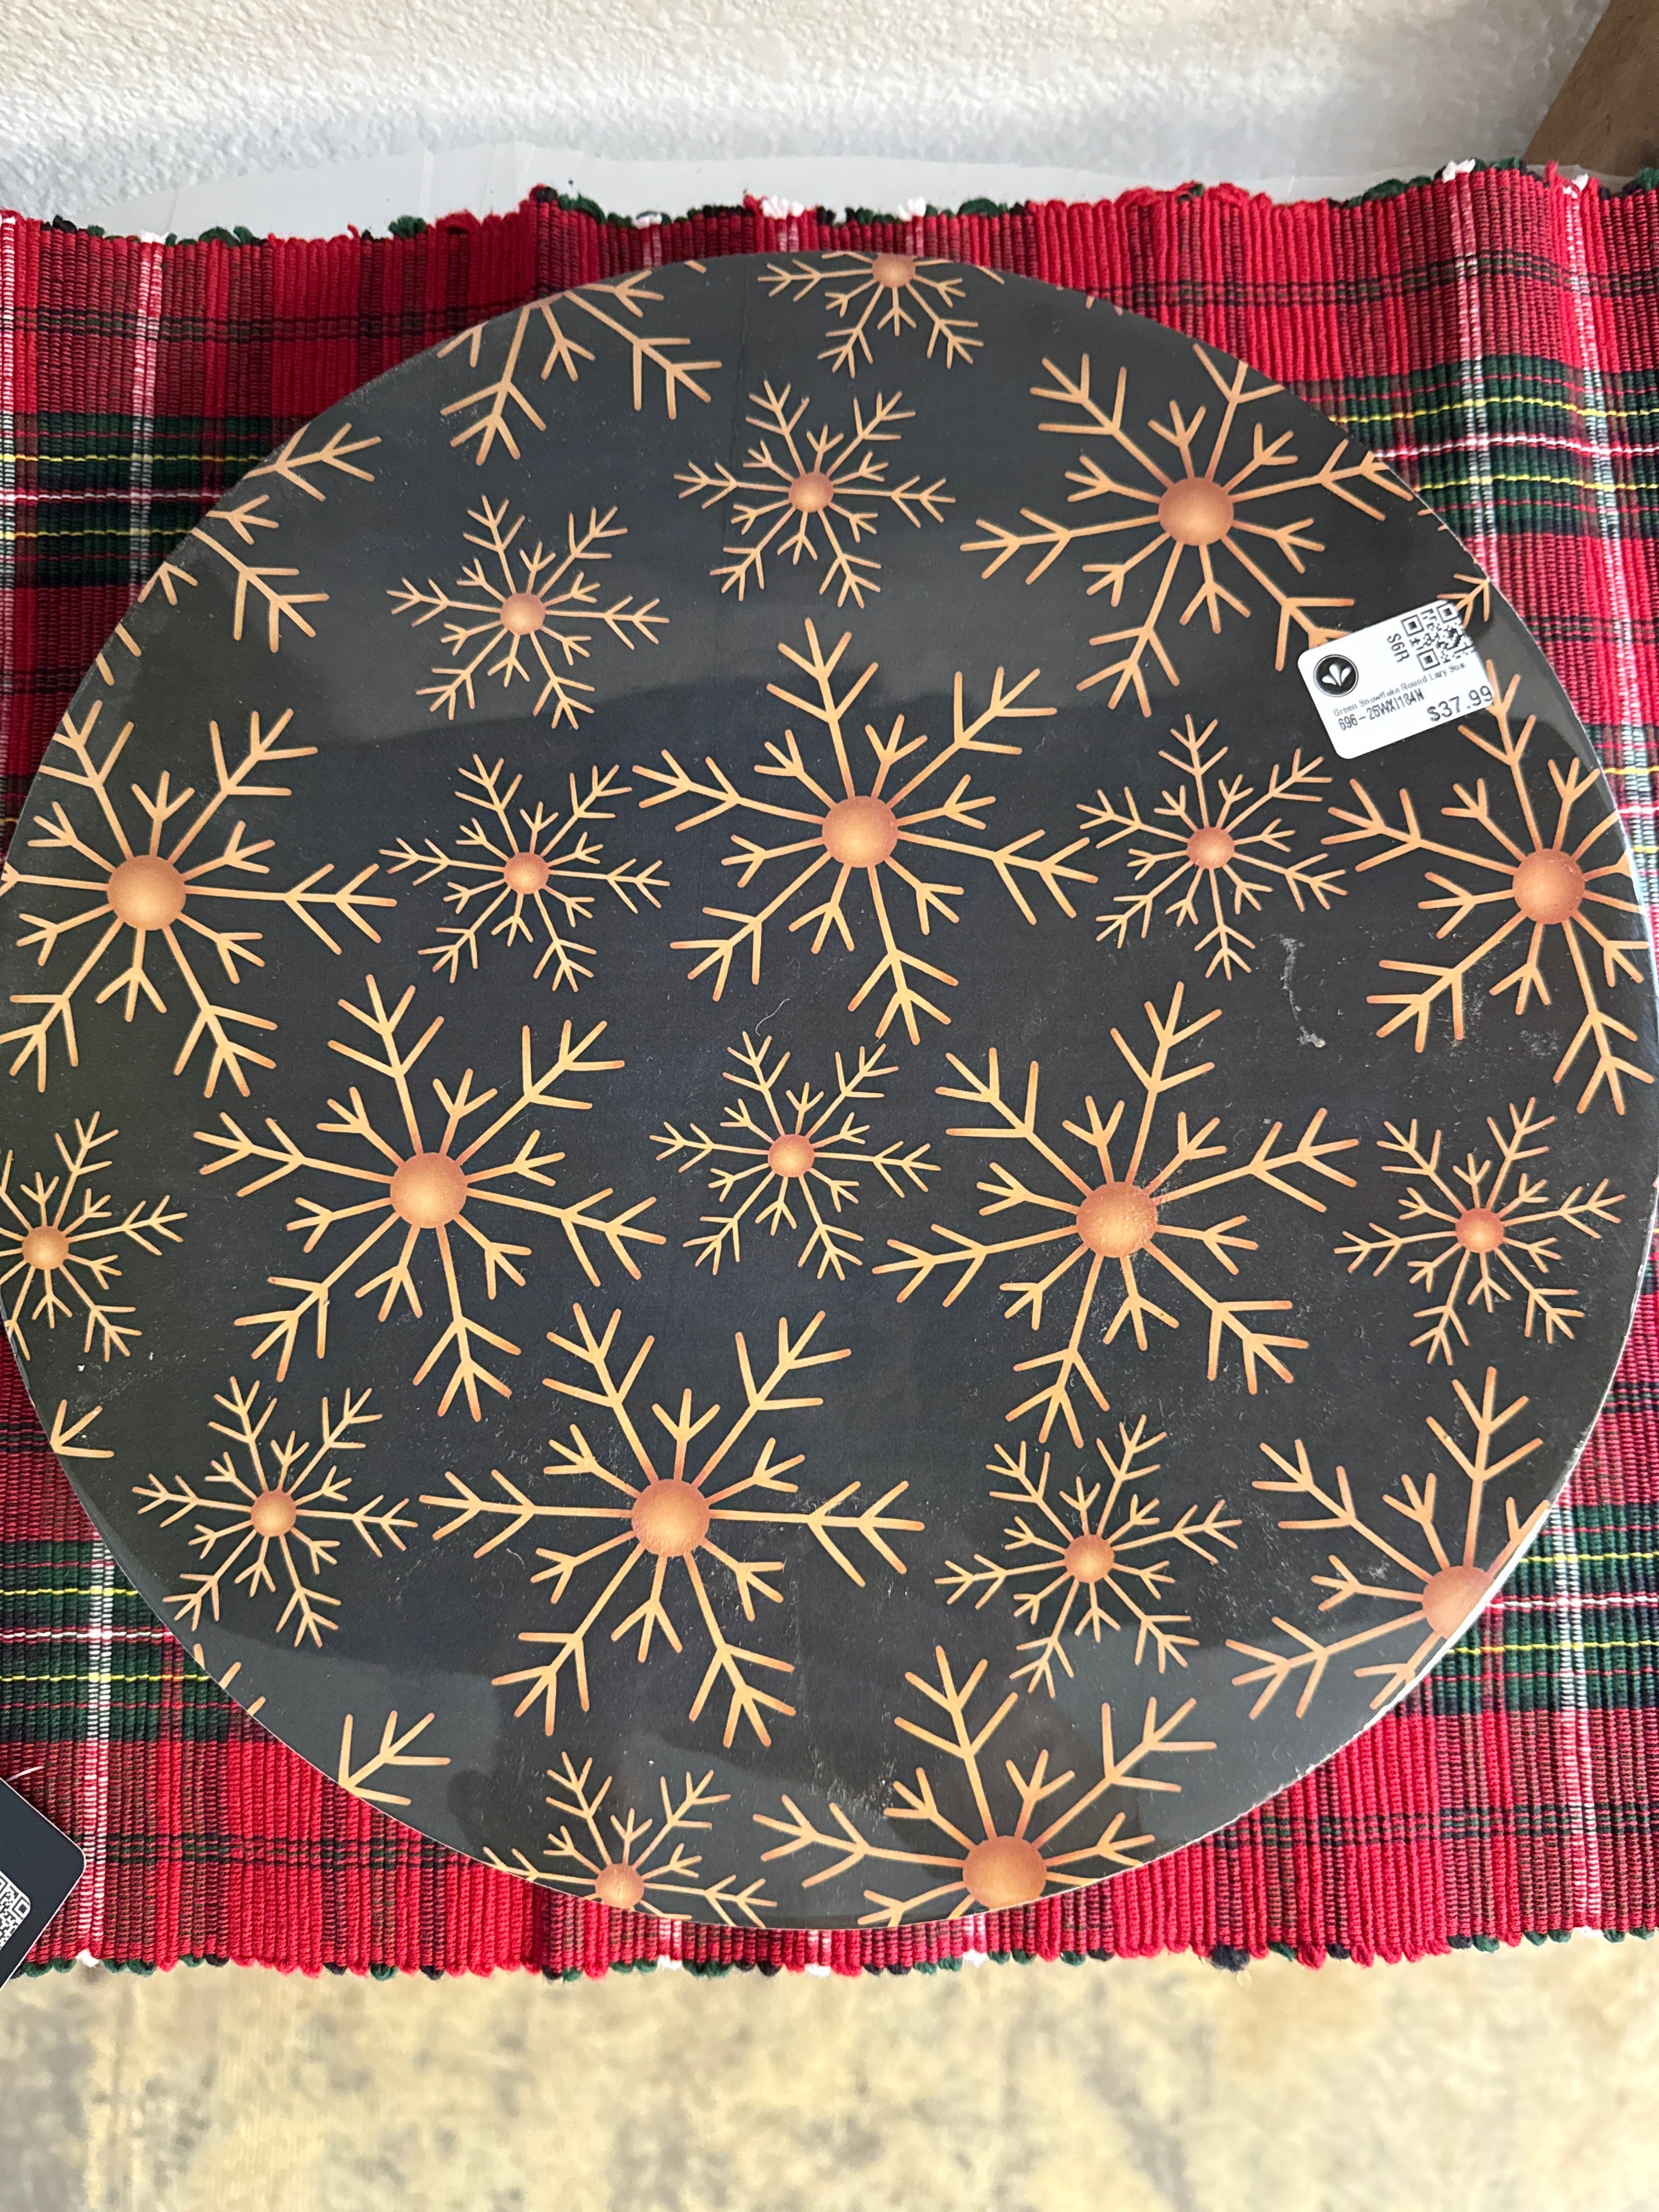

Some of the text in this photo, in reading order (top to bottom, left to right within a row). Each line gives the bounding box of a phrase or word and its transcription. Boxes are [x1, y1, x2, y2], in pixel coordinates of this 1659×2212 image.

[1387, 633, 1410, 663] S6R
[1333, 704, 1357, 716] Green
[1359, 687, 1400, 707] Snowflake
[1400, 675, 1427, 692] Round
[1428, 668, 1447, 681] Lazy
[1427, 685, 1493, 722] $37.99
